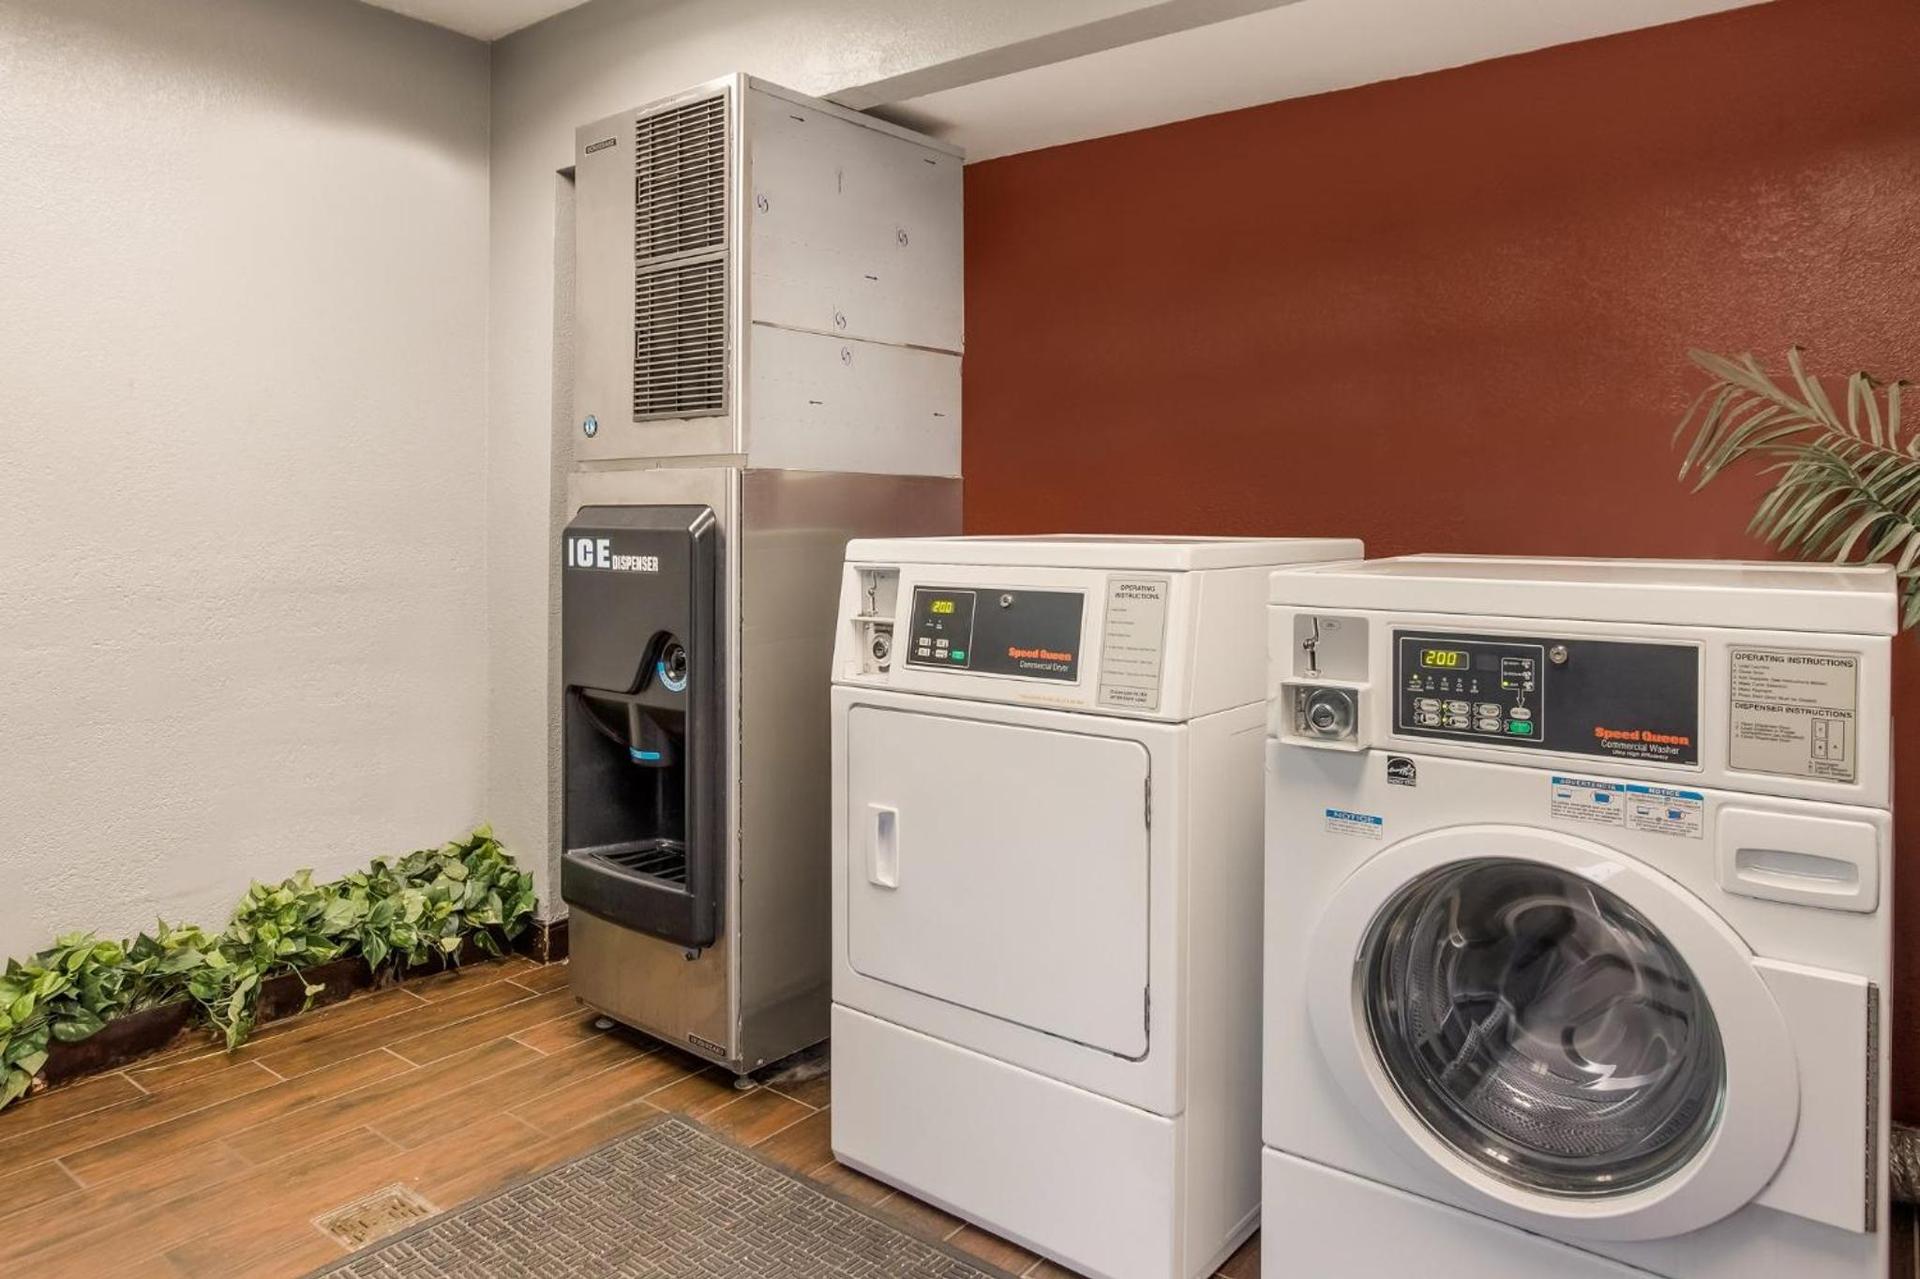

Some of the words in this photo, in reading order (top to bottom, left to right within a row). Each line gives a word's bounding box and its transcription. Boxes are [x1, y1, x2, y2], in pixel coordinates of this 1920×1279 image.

[568, 538, 611, 568] ICE
[612, 555, 659, 572] DISPENSER
[1120, 584, 1156, 592] OPERATING
[1115, 592, 1160, 600] INSTRUCTIONS
[932, 601, 953, 613] 200
[1008, 646, 1039, 658] Speed
[1040, 648, 1072, 661] Queen
[1426, 651, 1457, 666] 200
[1735, 653, 1785, 663] OPERATING
[1786, 657, 1854, 668] INSTRUCTIONS
[1020, 660, 1053, 670] Commercial
[1053, 663, 1069, 673] Dryer
[1735, 702, 1783, 712] DISPENSER
[1785, 706, 1853, 718] INSTRUCTIONS
[1594, 727, 1640, 740] Speed
[1641, 731, 1690, 745] Queen
[1601, 739, 1648, 751] Commercial
[1649, 743, 1680, 755] Washer
[1648, 787, 1680, 797] NOTICE
